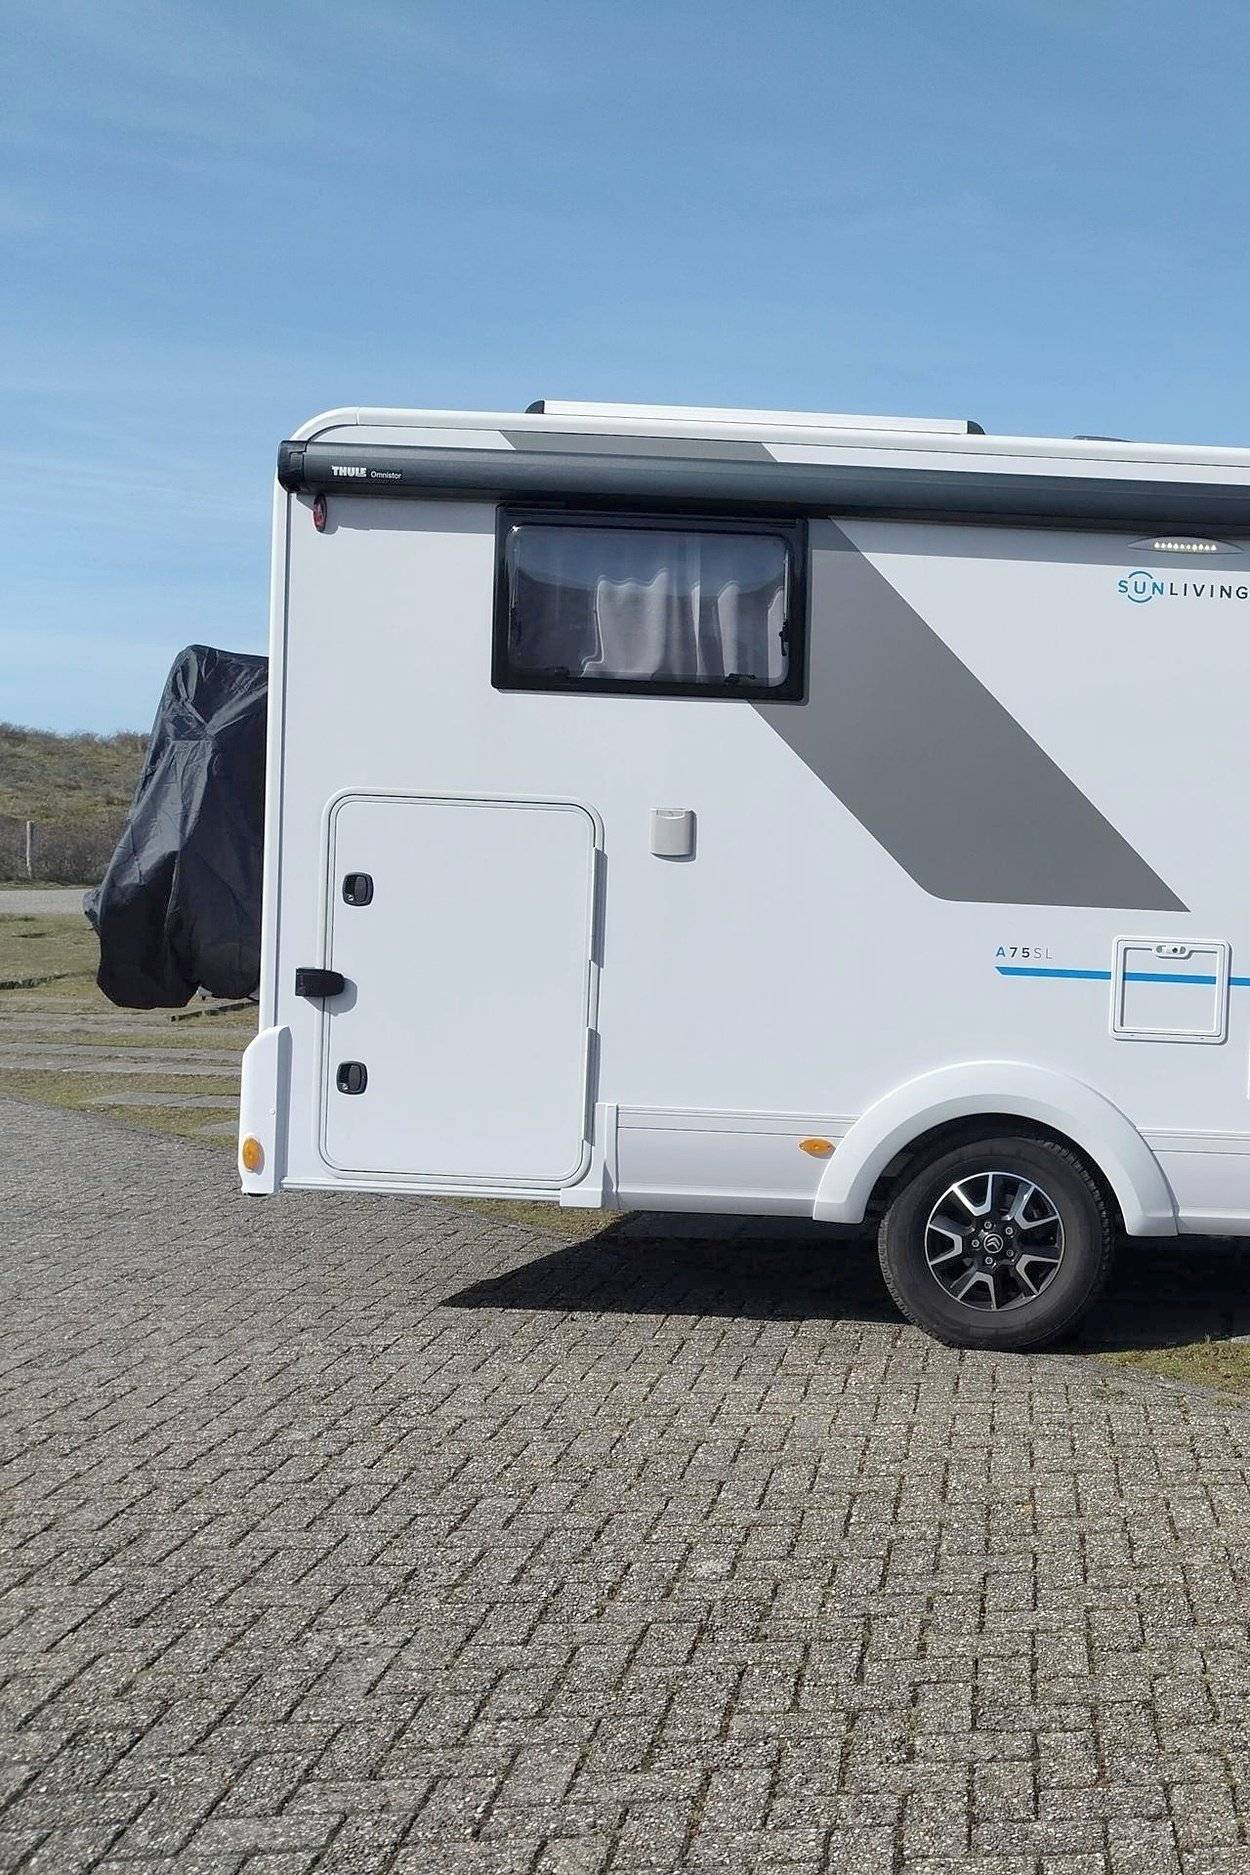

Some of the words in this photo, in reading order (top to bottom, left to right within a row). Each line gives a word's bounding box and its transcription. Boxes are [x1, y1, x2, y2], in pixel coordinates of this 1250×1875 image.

[332, 465, 367, 478] THULE
[370, 471, 402, 480] Omnistor
[1118, 578, 1249, 600] SUNLIVING
